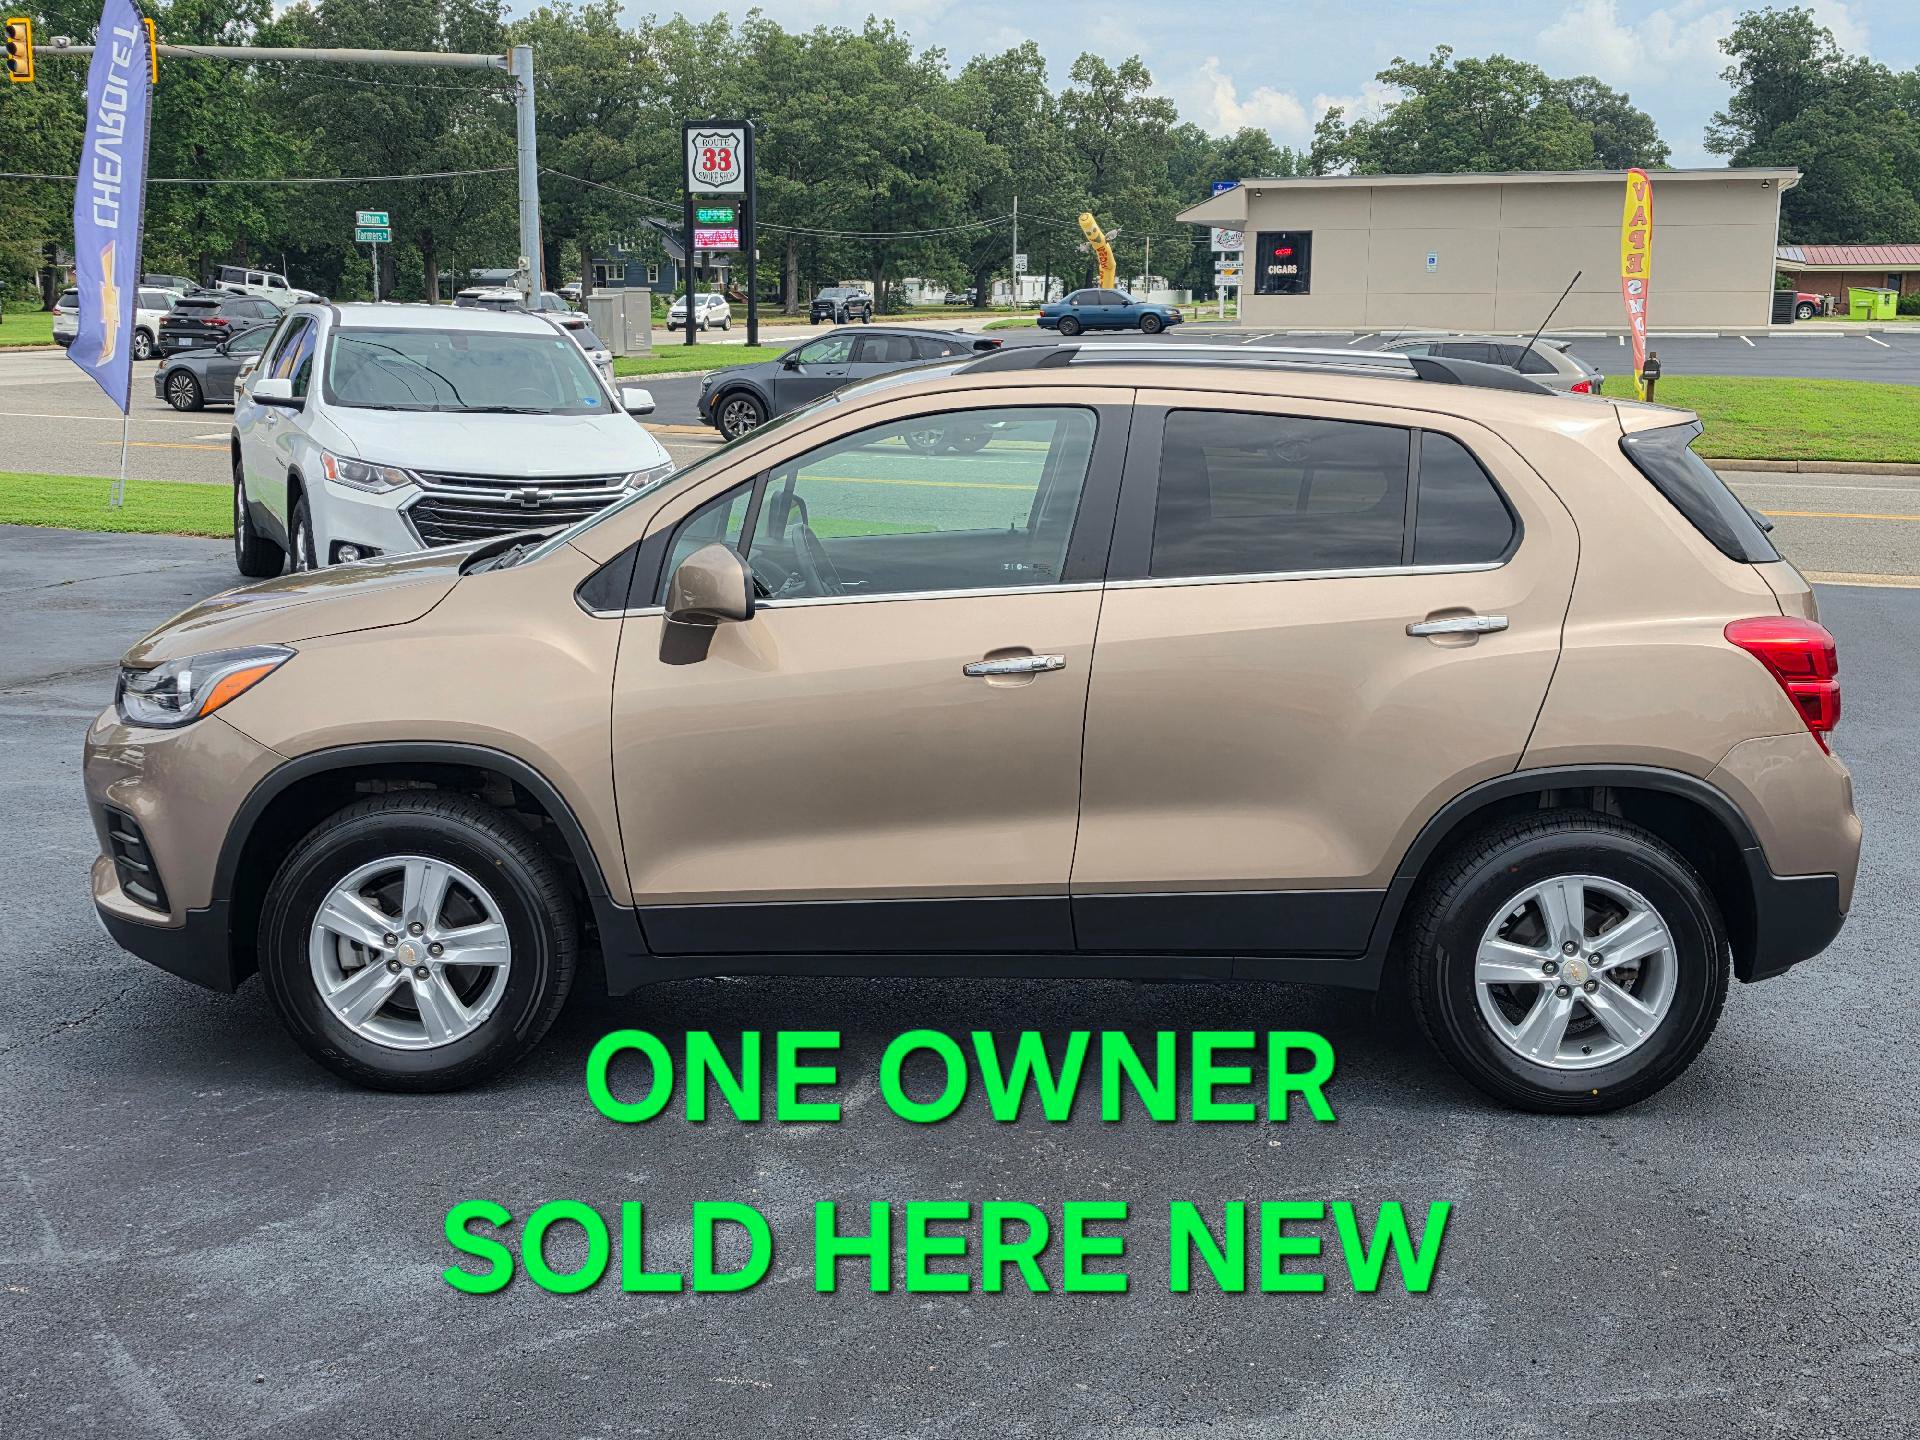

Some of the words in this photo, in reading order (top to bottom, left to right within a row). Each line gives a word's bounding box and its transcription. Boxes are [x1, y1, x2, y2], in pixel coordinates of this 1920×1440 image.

[702, 138, 730, 147] ROUTE
[702, 147, 732, 171] 33
[698, 171, 719, 183] SMOKE
[719, 171, 735, 182] SHOP
[359, 213, 381, 224] Eltham
[357, 229, 383, 240] Farmers
[1015, 262, 1027, 270] 45
[1268, 264, 1298, 275] CIGARS
